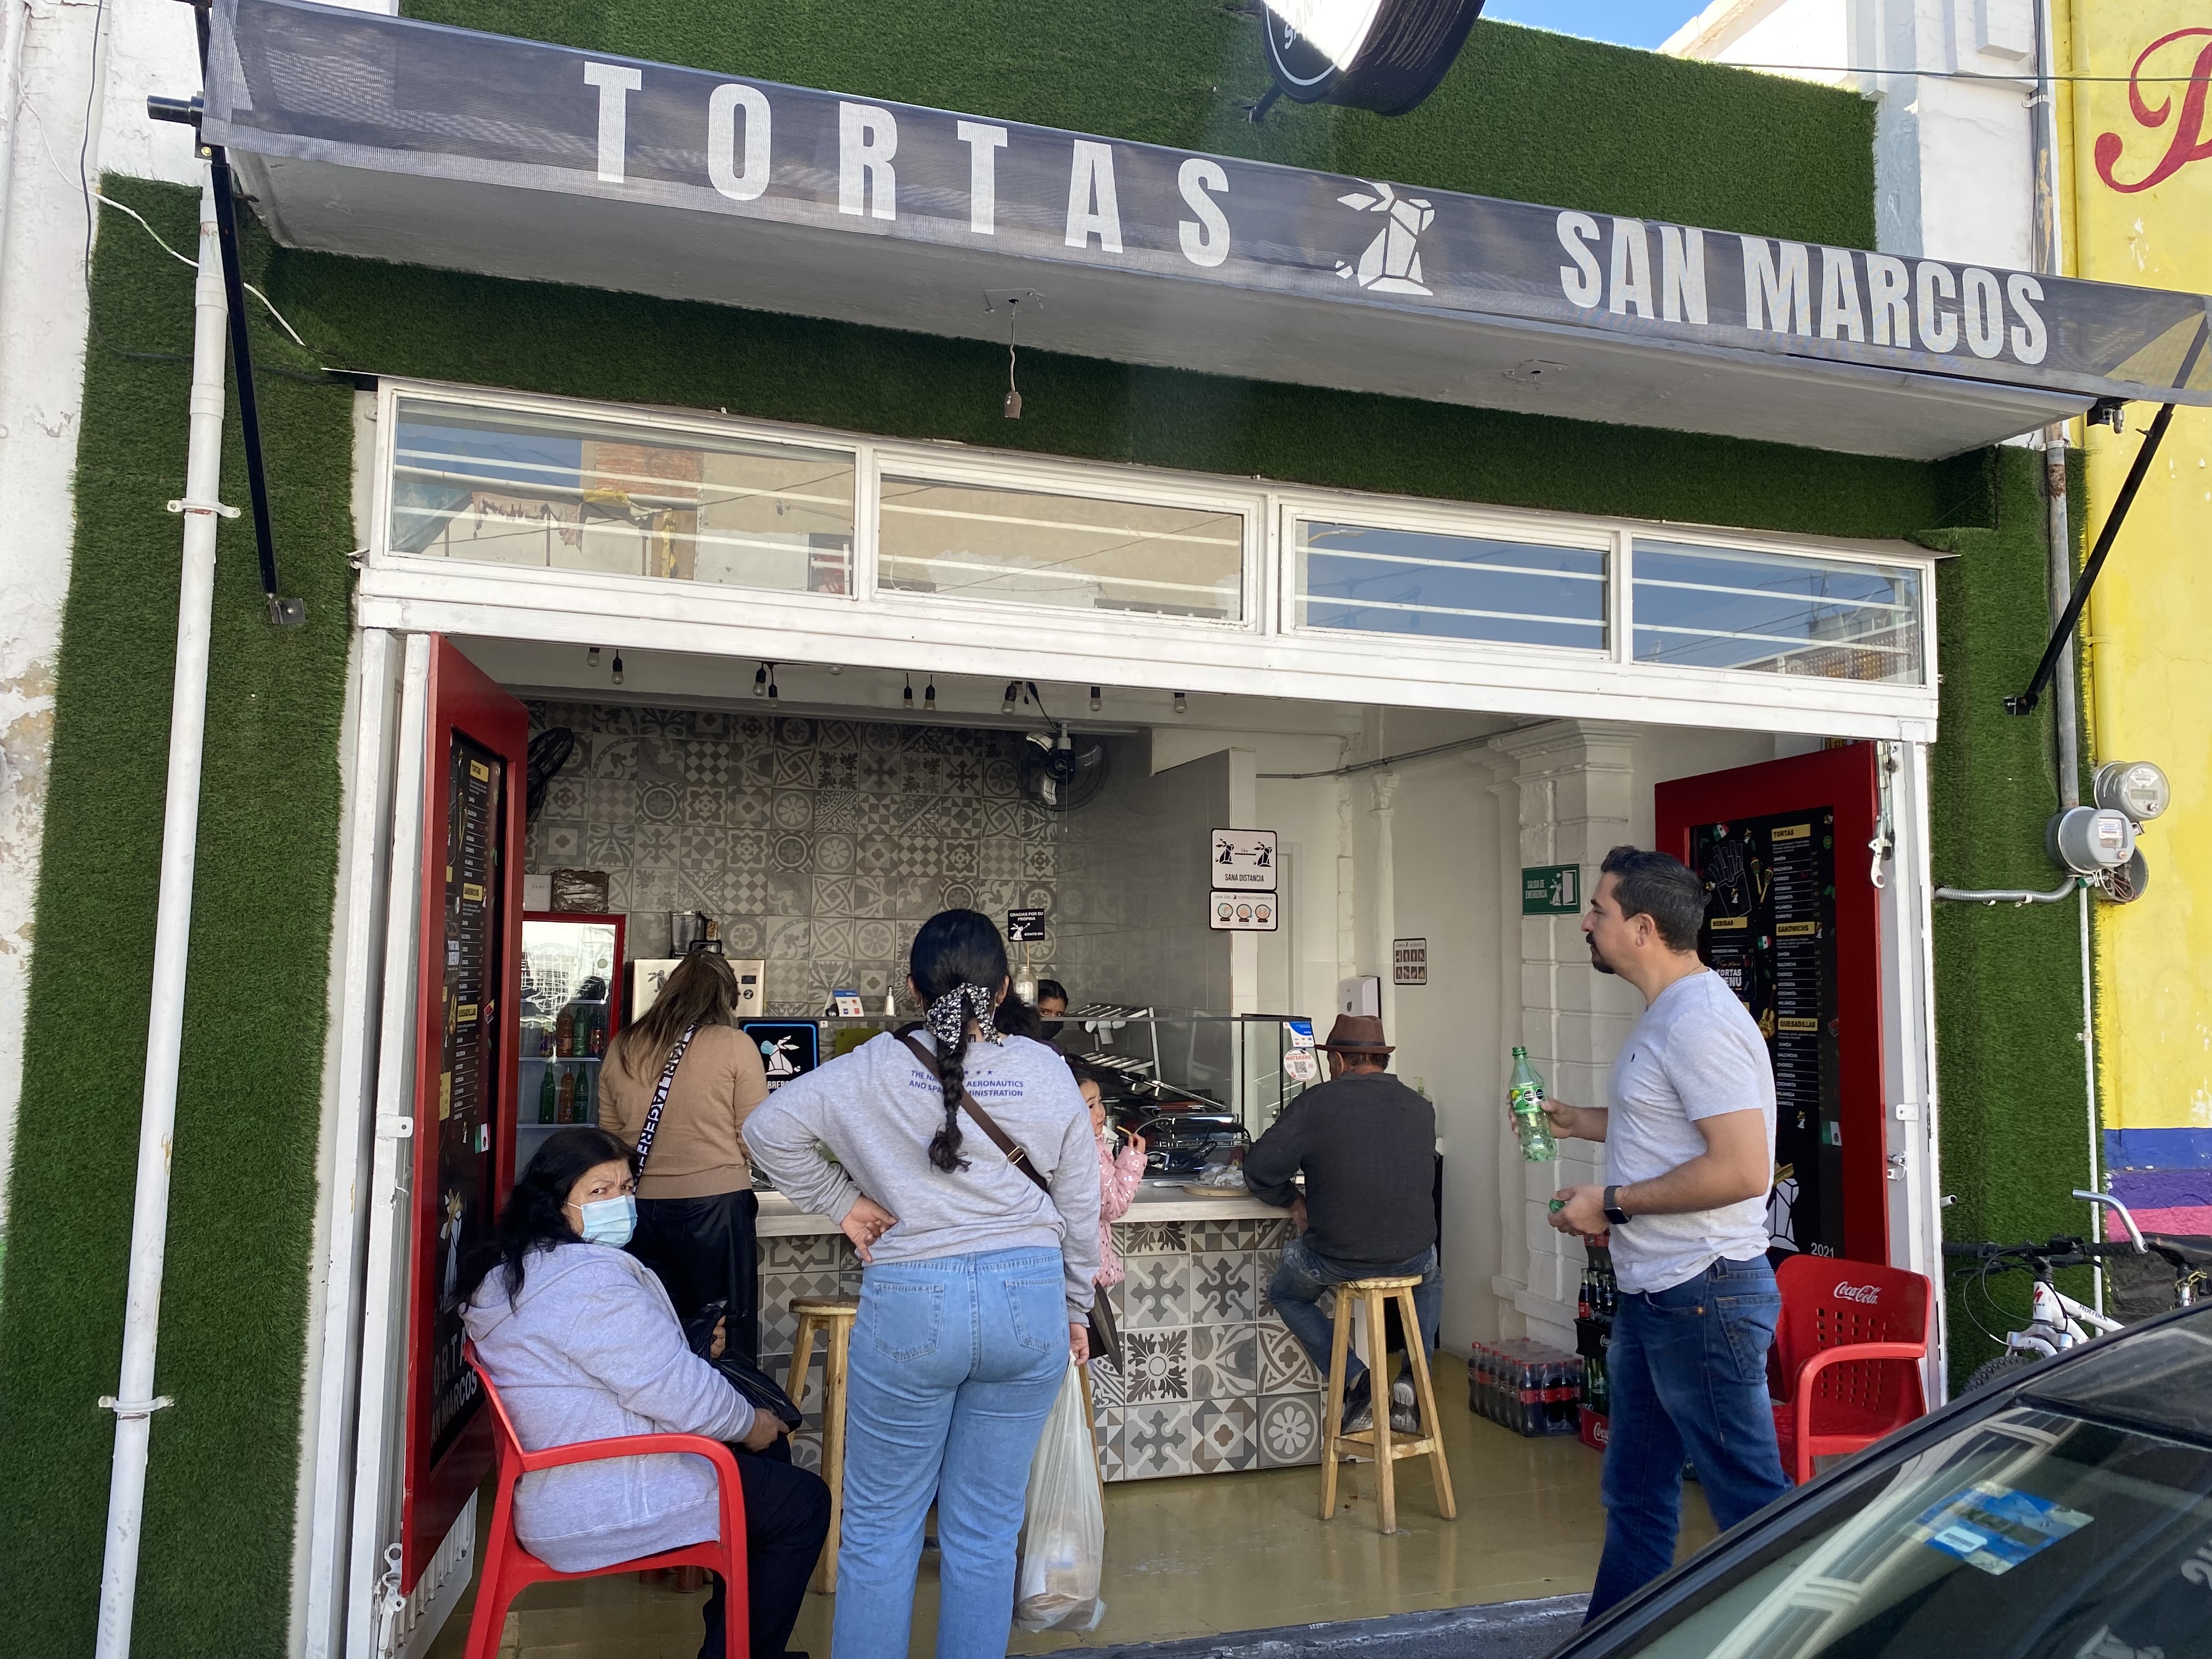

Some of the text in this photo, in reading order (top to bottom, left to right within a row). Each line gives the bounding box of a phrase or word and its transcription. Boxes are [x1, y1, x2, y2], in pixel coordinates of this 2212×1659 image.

[584, 61, 2048, 365] TORTAS SAN MARCOS
[1773, 830, 1795, 838] TORTAS
[1224, 873, 1265, 882] SANA DISTANCIA
[1724, 977, 1742, 987] ENU
[911, 1070, 924, 1079] THE
[909, 1080, 927, 1090] AND
[1810, 1242, 1835, 1259] 2021
[433, 1326, 466, 1397] ORTA
